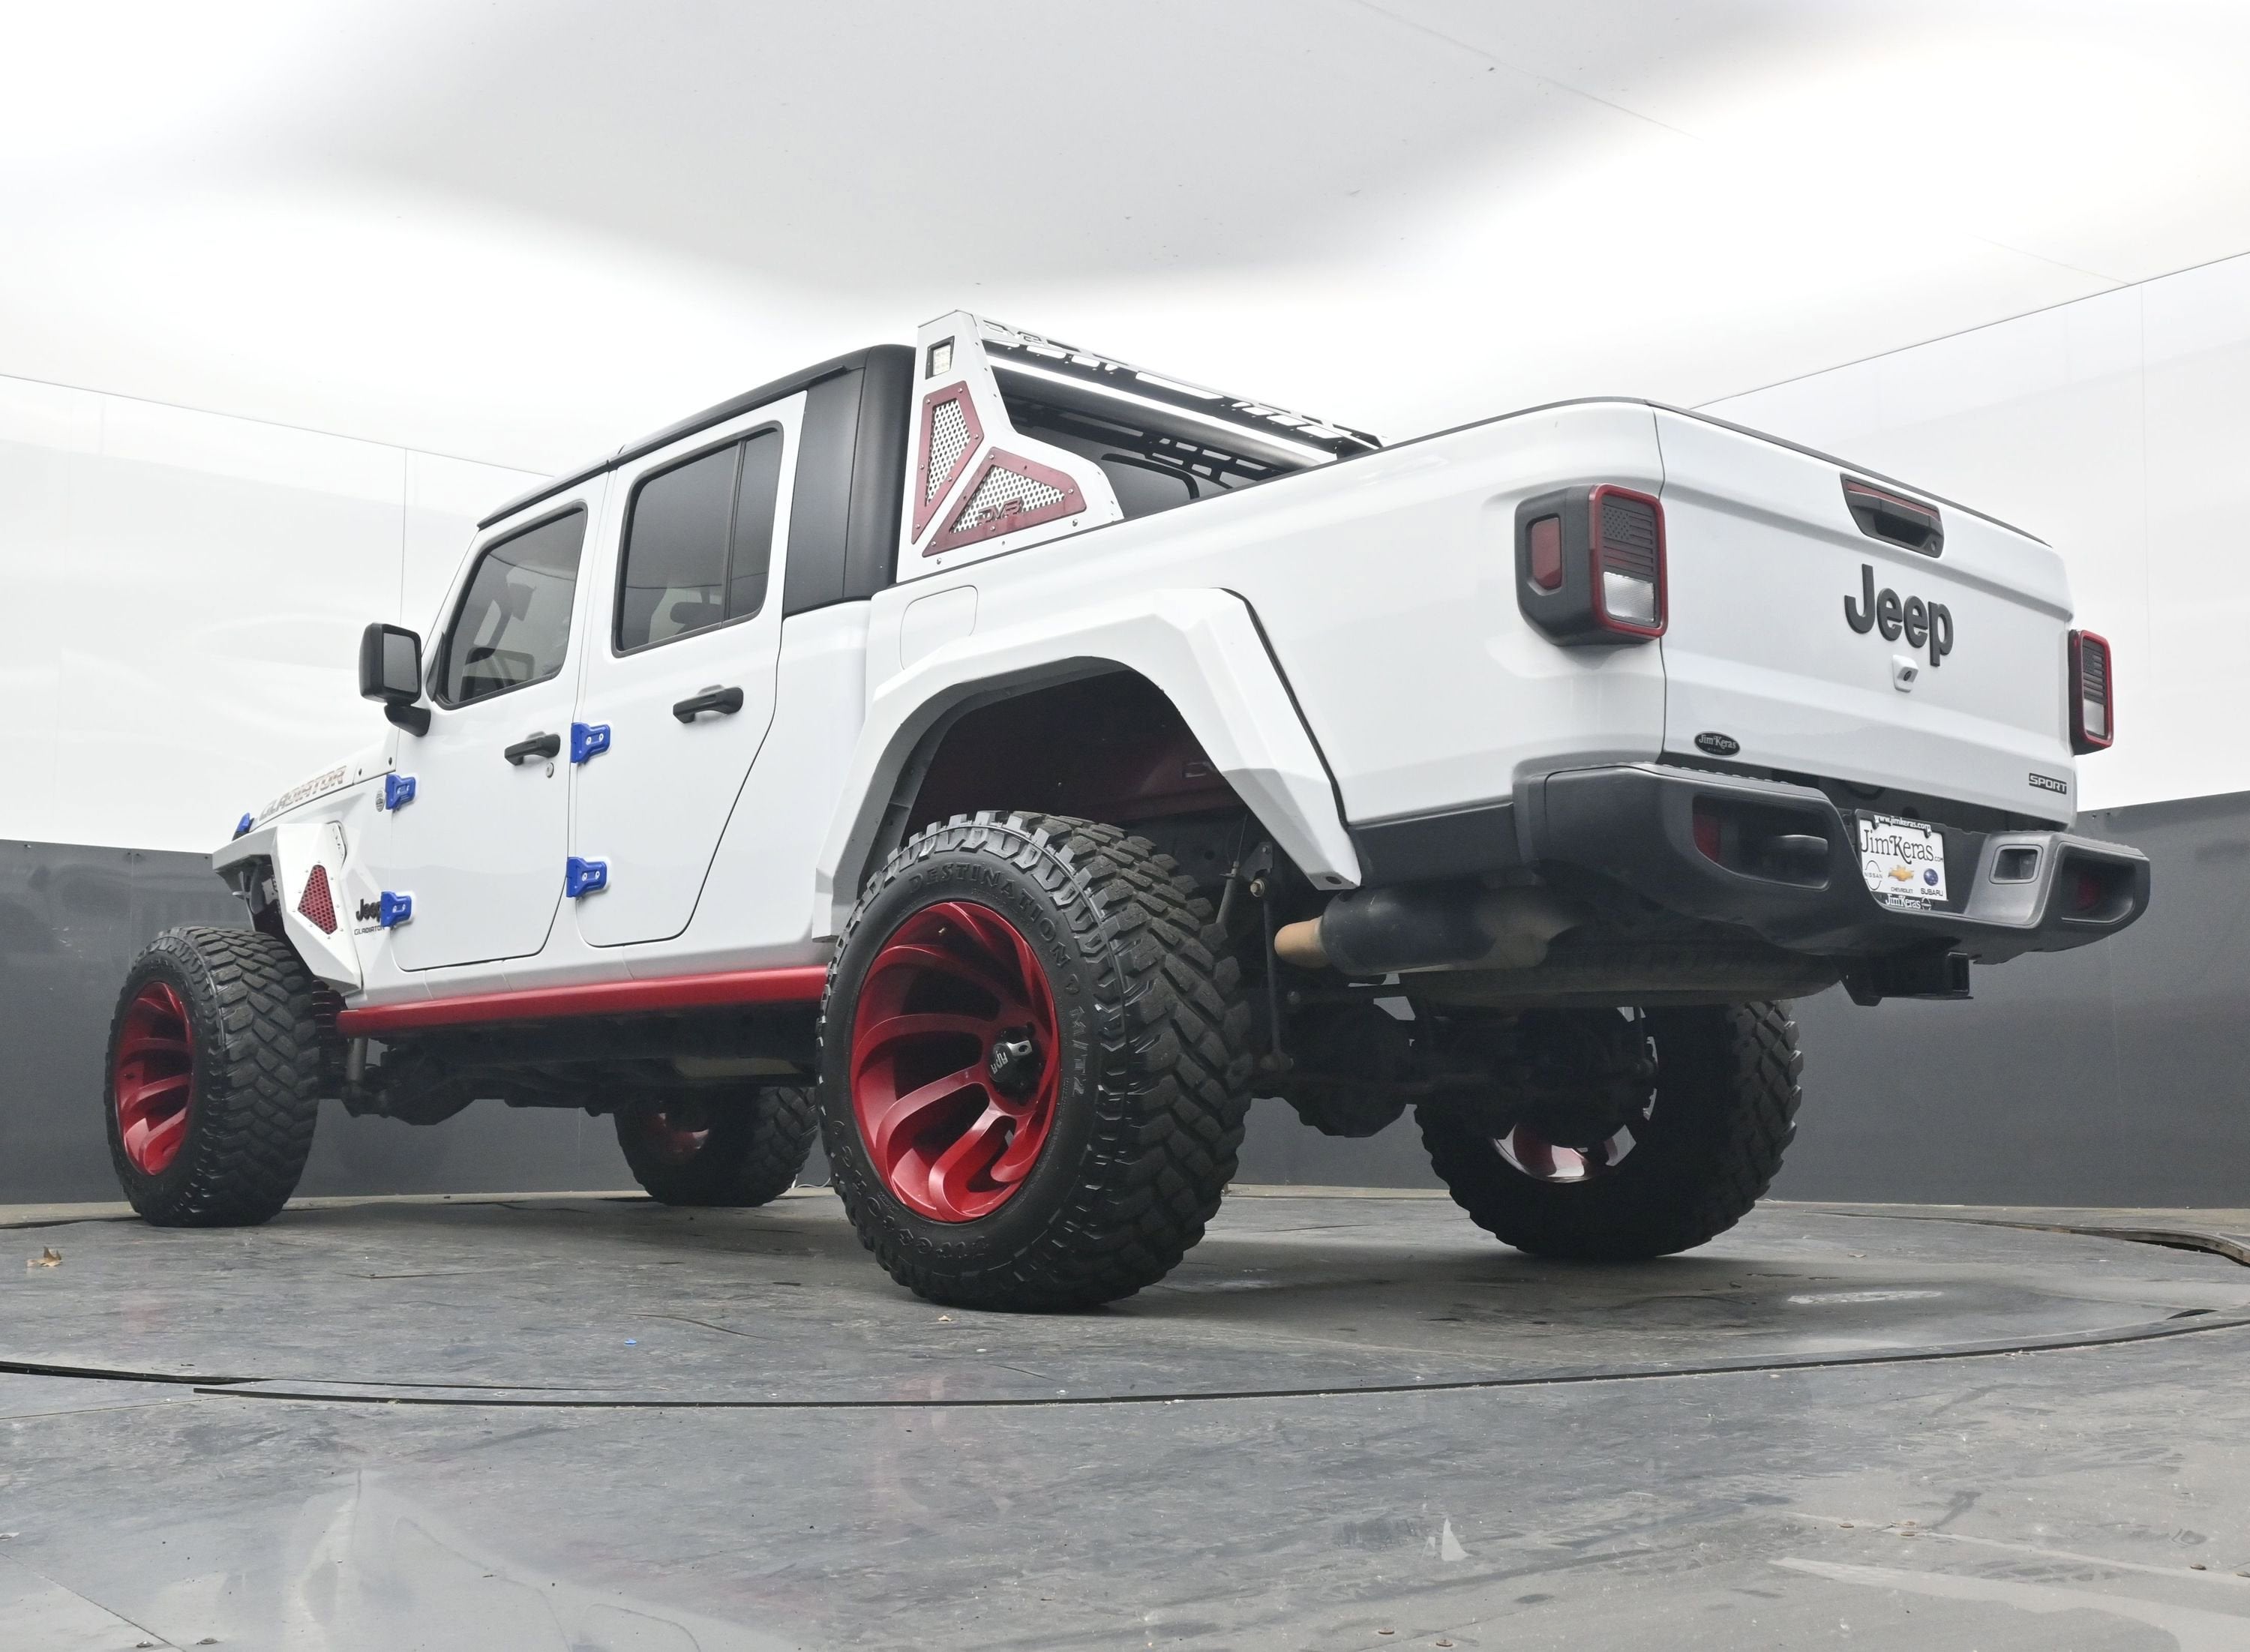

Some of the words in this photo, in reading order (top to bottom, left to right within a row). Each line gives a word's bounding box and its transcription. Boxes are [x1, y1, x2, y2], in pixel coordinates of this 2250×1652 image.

[1844, 563, 1954, 667] Jeep
[2029, 774, 2067, 793] SPORT
[1874, 814, 1931, 831] www.jimkeras.com
[1920, 887, 1944, 897] SUBARU
[908, 863, 1071, 967] DESTINATION
